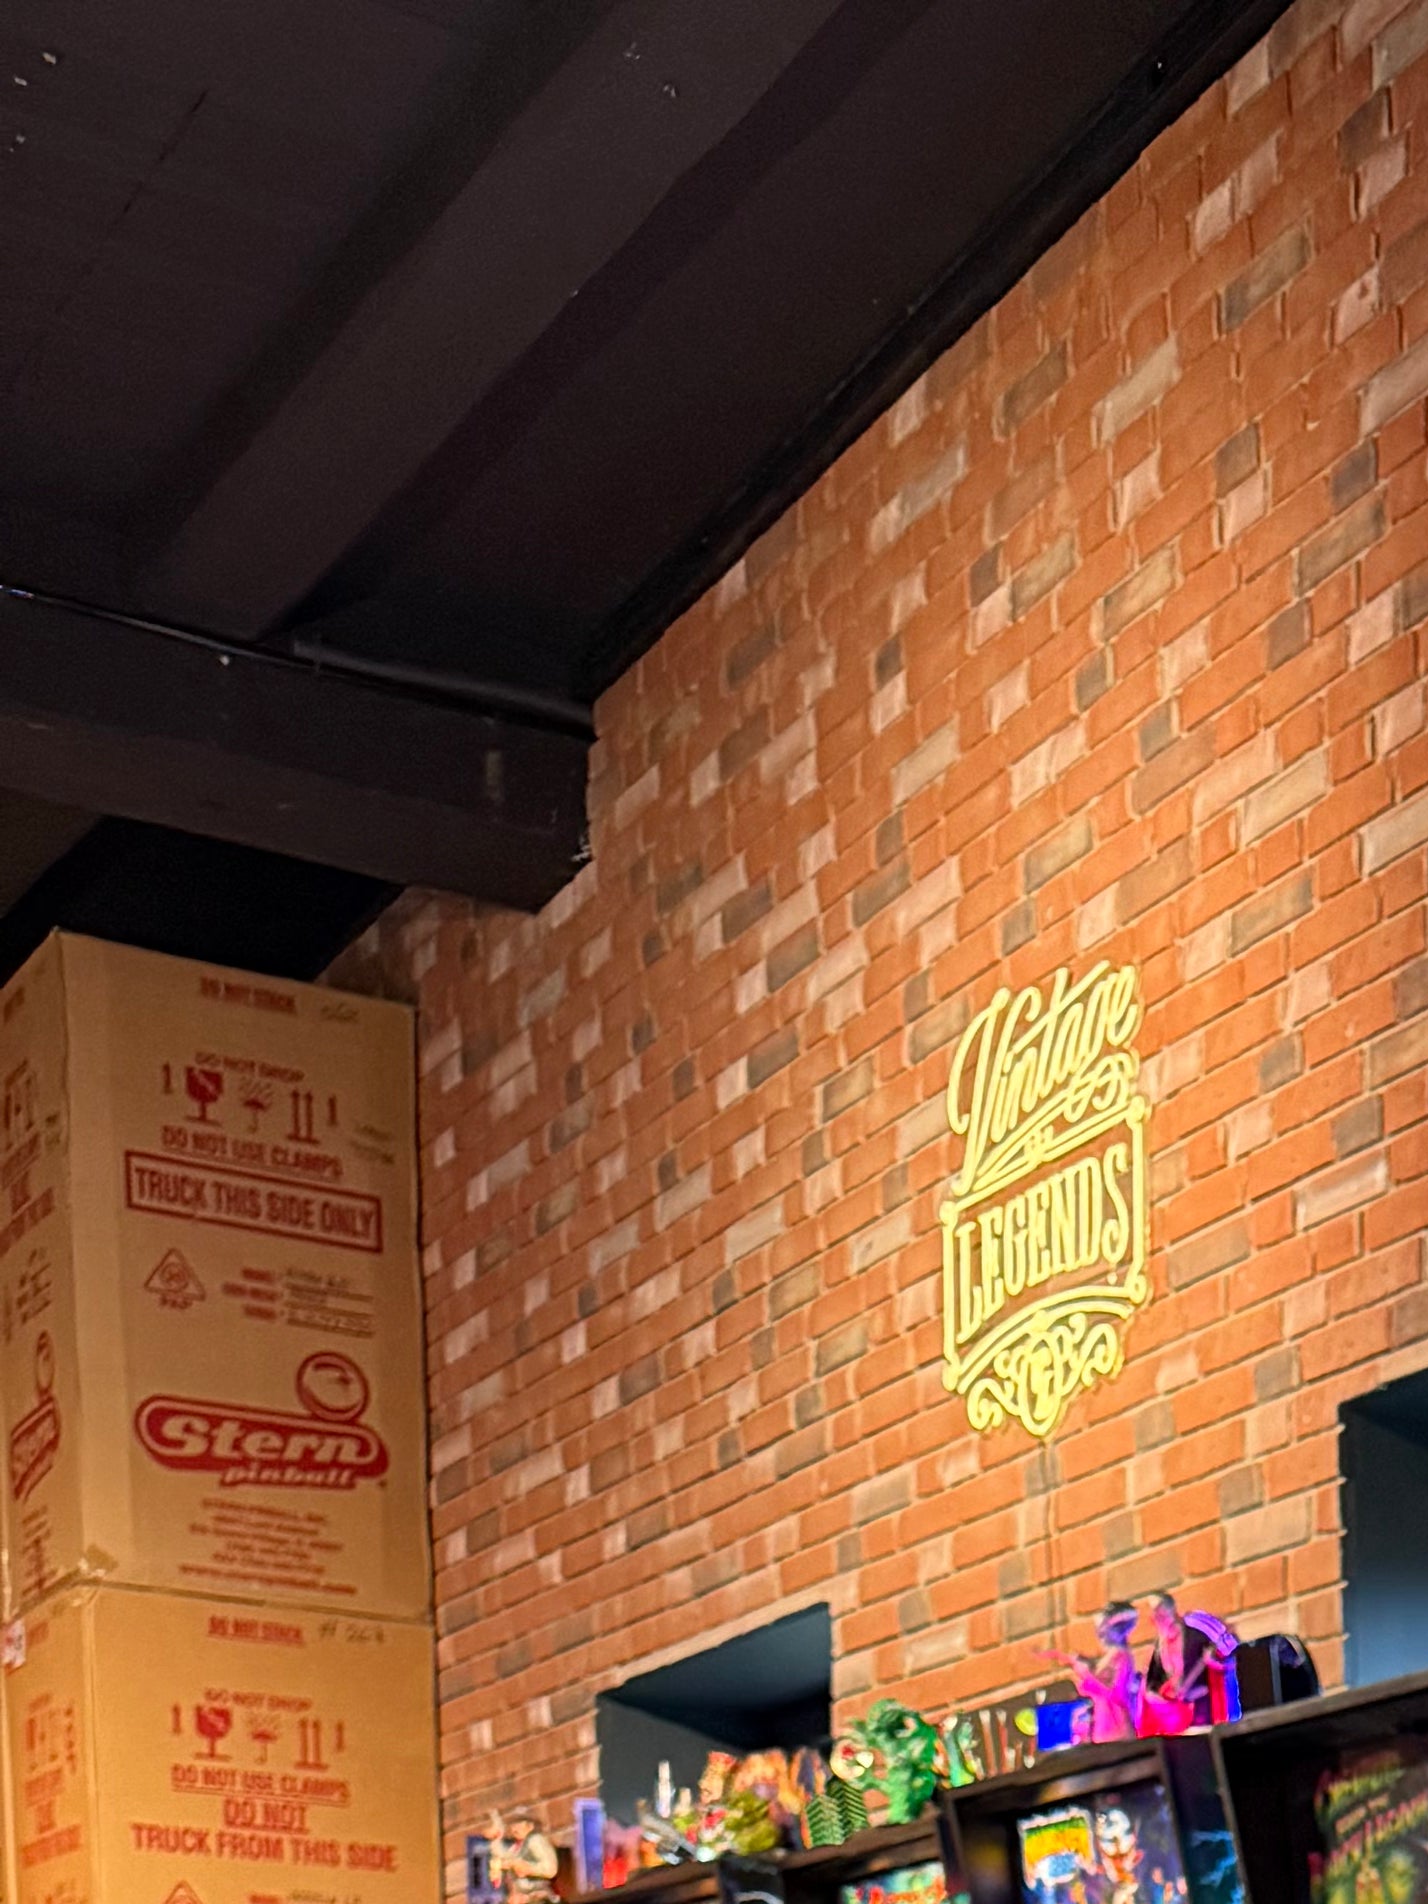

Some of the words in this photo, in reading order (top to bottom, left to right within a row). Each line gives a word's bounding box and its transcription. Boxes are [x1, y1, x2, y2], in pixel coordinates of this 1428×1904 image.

[948, 960, 1138, 1196] Vintage
[134, 1166, 207, 1210] TRUCK
[212, 1180, 261, 1219] THIS
[265, 1191, 316, 1230] SIDE
[320, 1201, 375, 1238] ONLY
[957, 1142, 1129, 1344] LEGENDS
[161, 1414, 377, 1465] Stern
[222, 1457, 354, 1487] pinball
[171, 1763, 198, 1785] DO
[201, 1766, 237, 1788] NOT
[223, 1797, 256, 1827] DO
[261, 1801, 307, 1831] NOT
[131, 1822, 210, 1854] TRUCK
[215, 1830, 283, 1861] FROM
[290, 1837, 341, 1868] THIS
[346, 1843, 398, 1873] SIDE
